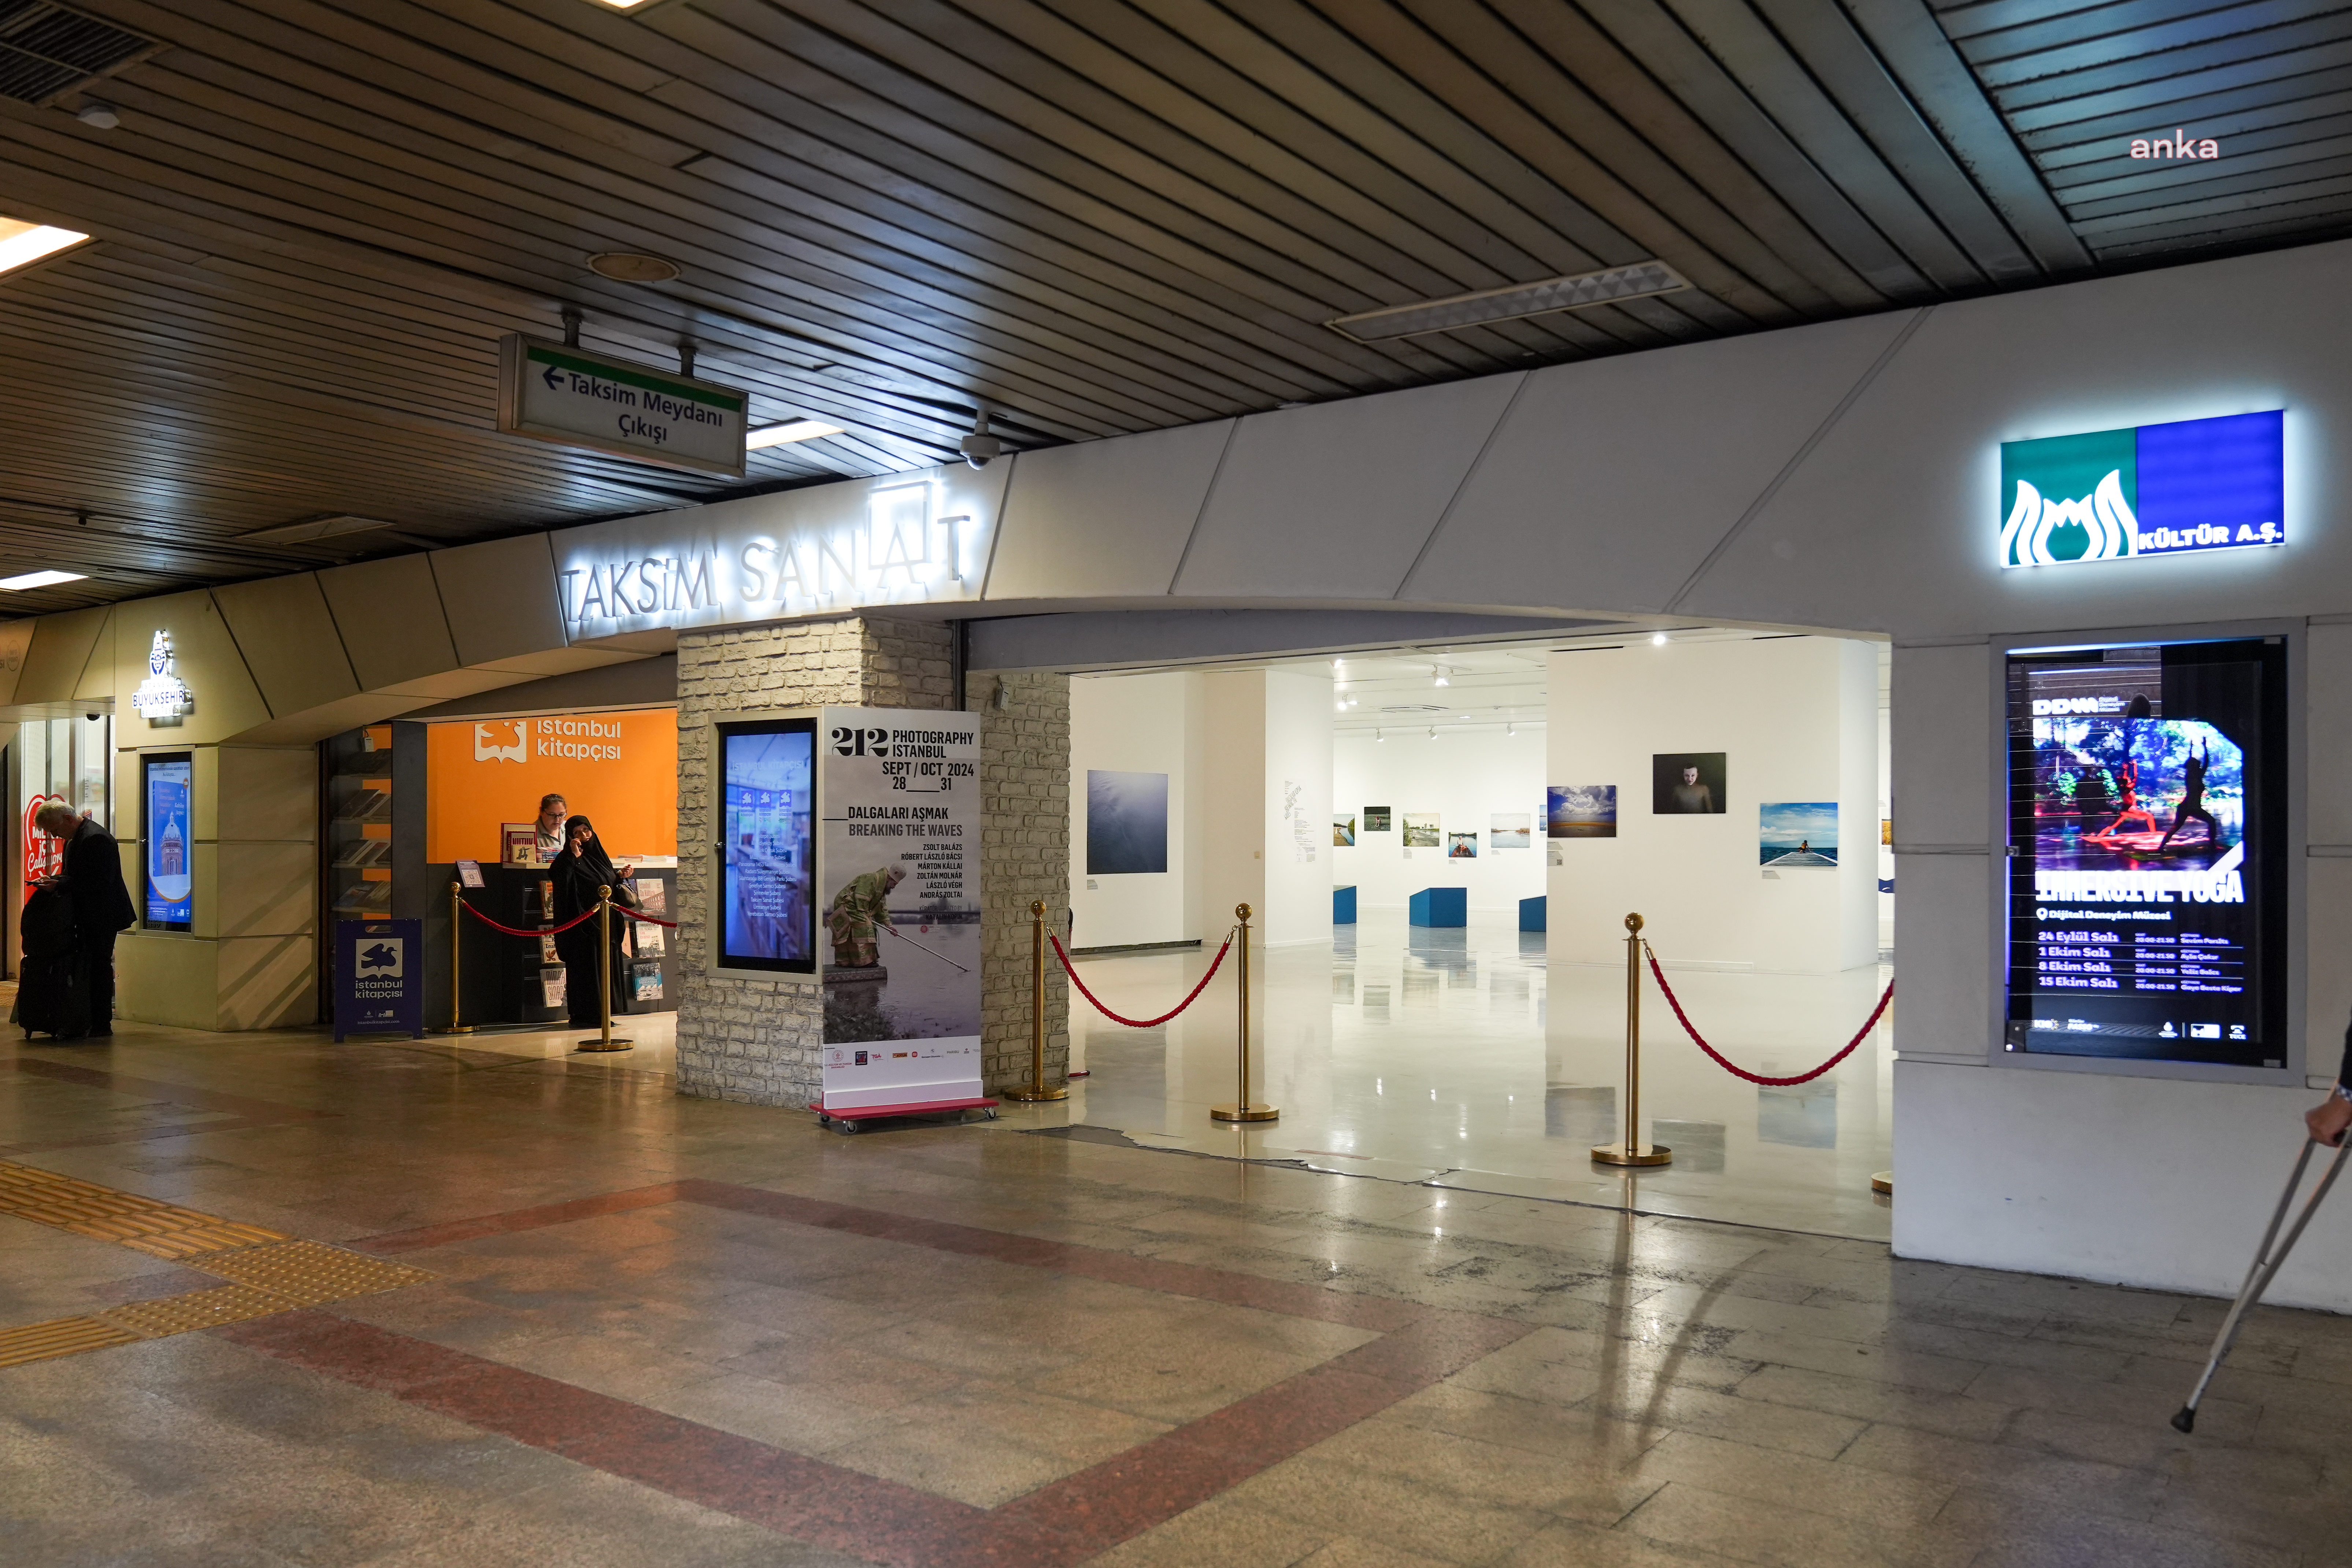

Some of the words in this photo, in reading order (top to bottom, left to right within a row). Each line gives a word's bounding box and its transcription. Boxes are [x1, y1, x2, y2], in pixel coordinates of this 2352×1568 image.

[569, 372, 636, 407] Taksim
[644, 392, 723, 427] Meydanı
[619, 414, 667, 444] Çıkışı
[2138, 523, 2229, 550] KÜLTÜR
[2236, 522, 2283, 543] A.Ş.
[562, 550, 719, 622] TAKSİM
[739, 515, 971, 602] SANAT
[142, 680, 173, 689] İSTANBUL
[133, 687, 184, 708] BÜYÜKŞEHİR
[832, 727, 889, 757] 212
[893, 730, 974, 745] PHOTOGRAPHY
[537, 737, 620, 761] kitapçısı
[893, 744, 947, 758] ISTANBUL
[882, 761, 911, 775] SEPT
[921, 763, 943, 776] OCT
[948, 763, 974, 776] 2024
[893, 776, 906, 790] 28
[941, 777, 951, 790] 31
[848, 807, 909, 819] DALGALARI
[911, 807, 948, 822] AŞMAK
[849, 824, 903, 836] BREAKING
[905, 824, 925, 836] THE
[928, 824, 963, 836] WAVES
[941, 842, 962, 850] BALÁZS
[918, 861, 941, 870] MÁRTON
[942, 861, 962, 869] KÁLLAI
[917, 871, 938, 879] ZOLTÁN
[939, 870, 962, 879] MOLNÁR
[926, 881, 947, 889] LÁSZLÓ
[2178, 870, 2244, 903] YOGA
[920, 890, 942, 898] ANDRÁS
[2049, 910, 2085, 920] Dijital
[2085, 911, 2131, 921] Deneyim
[2133, 911, 2172, 920] Müzesi
[2038, 931, 2055, 941] 24
[2056, 931, 2090, 943] Eylül
[2091, 932, 2120, 942] Salı
[2039, 947, 2047, 956] 1
[2048, 946, 2082, 957] Ekim
[2083, 947, 2112, 958] Salı
[2039, 961, 2047, 971] 8
[2049, 961, 2082, 972] Ekim
[2083, 962, 2112, 972] Salı
[356, 980, 402, 989] istanbul
[2039, 976, 2054, 986] 15
[2056, 976, 2089, 987] Ekim
[2090, 978, 2119, 988] Salı
[355, 990, 403, 999] kitapçısı
